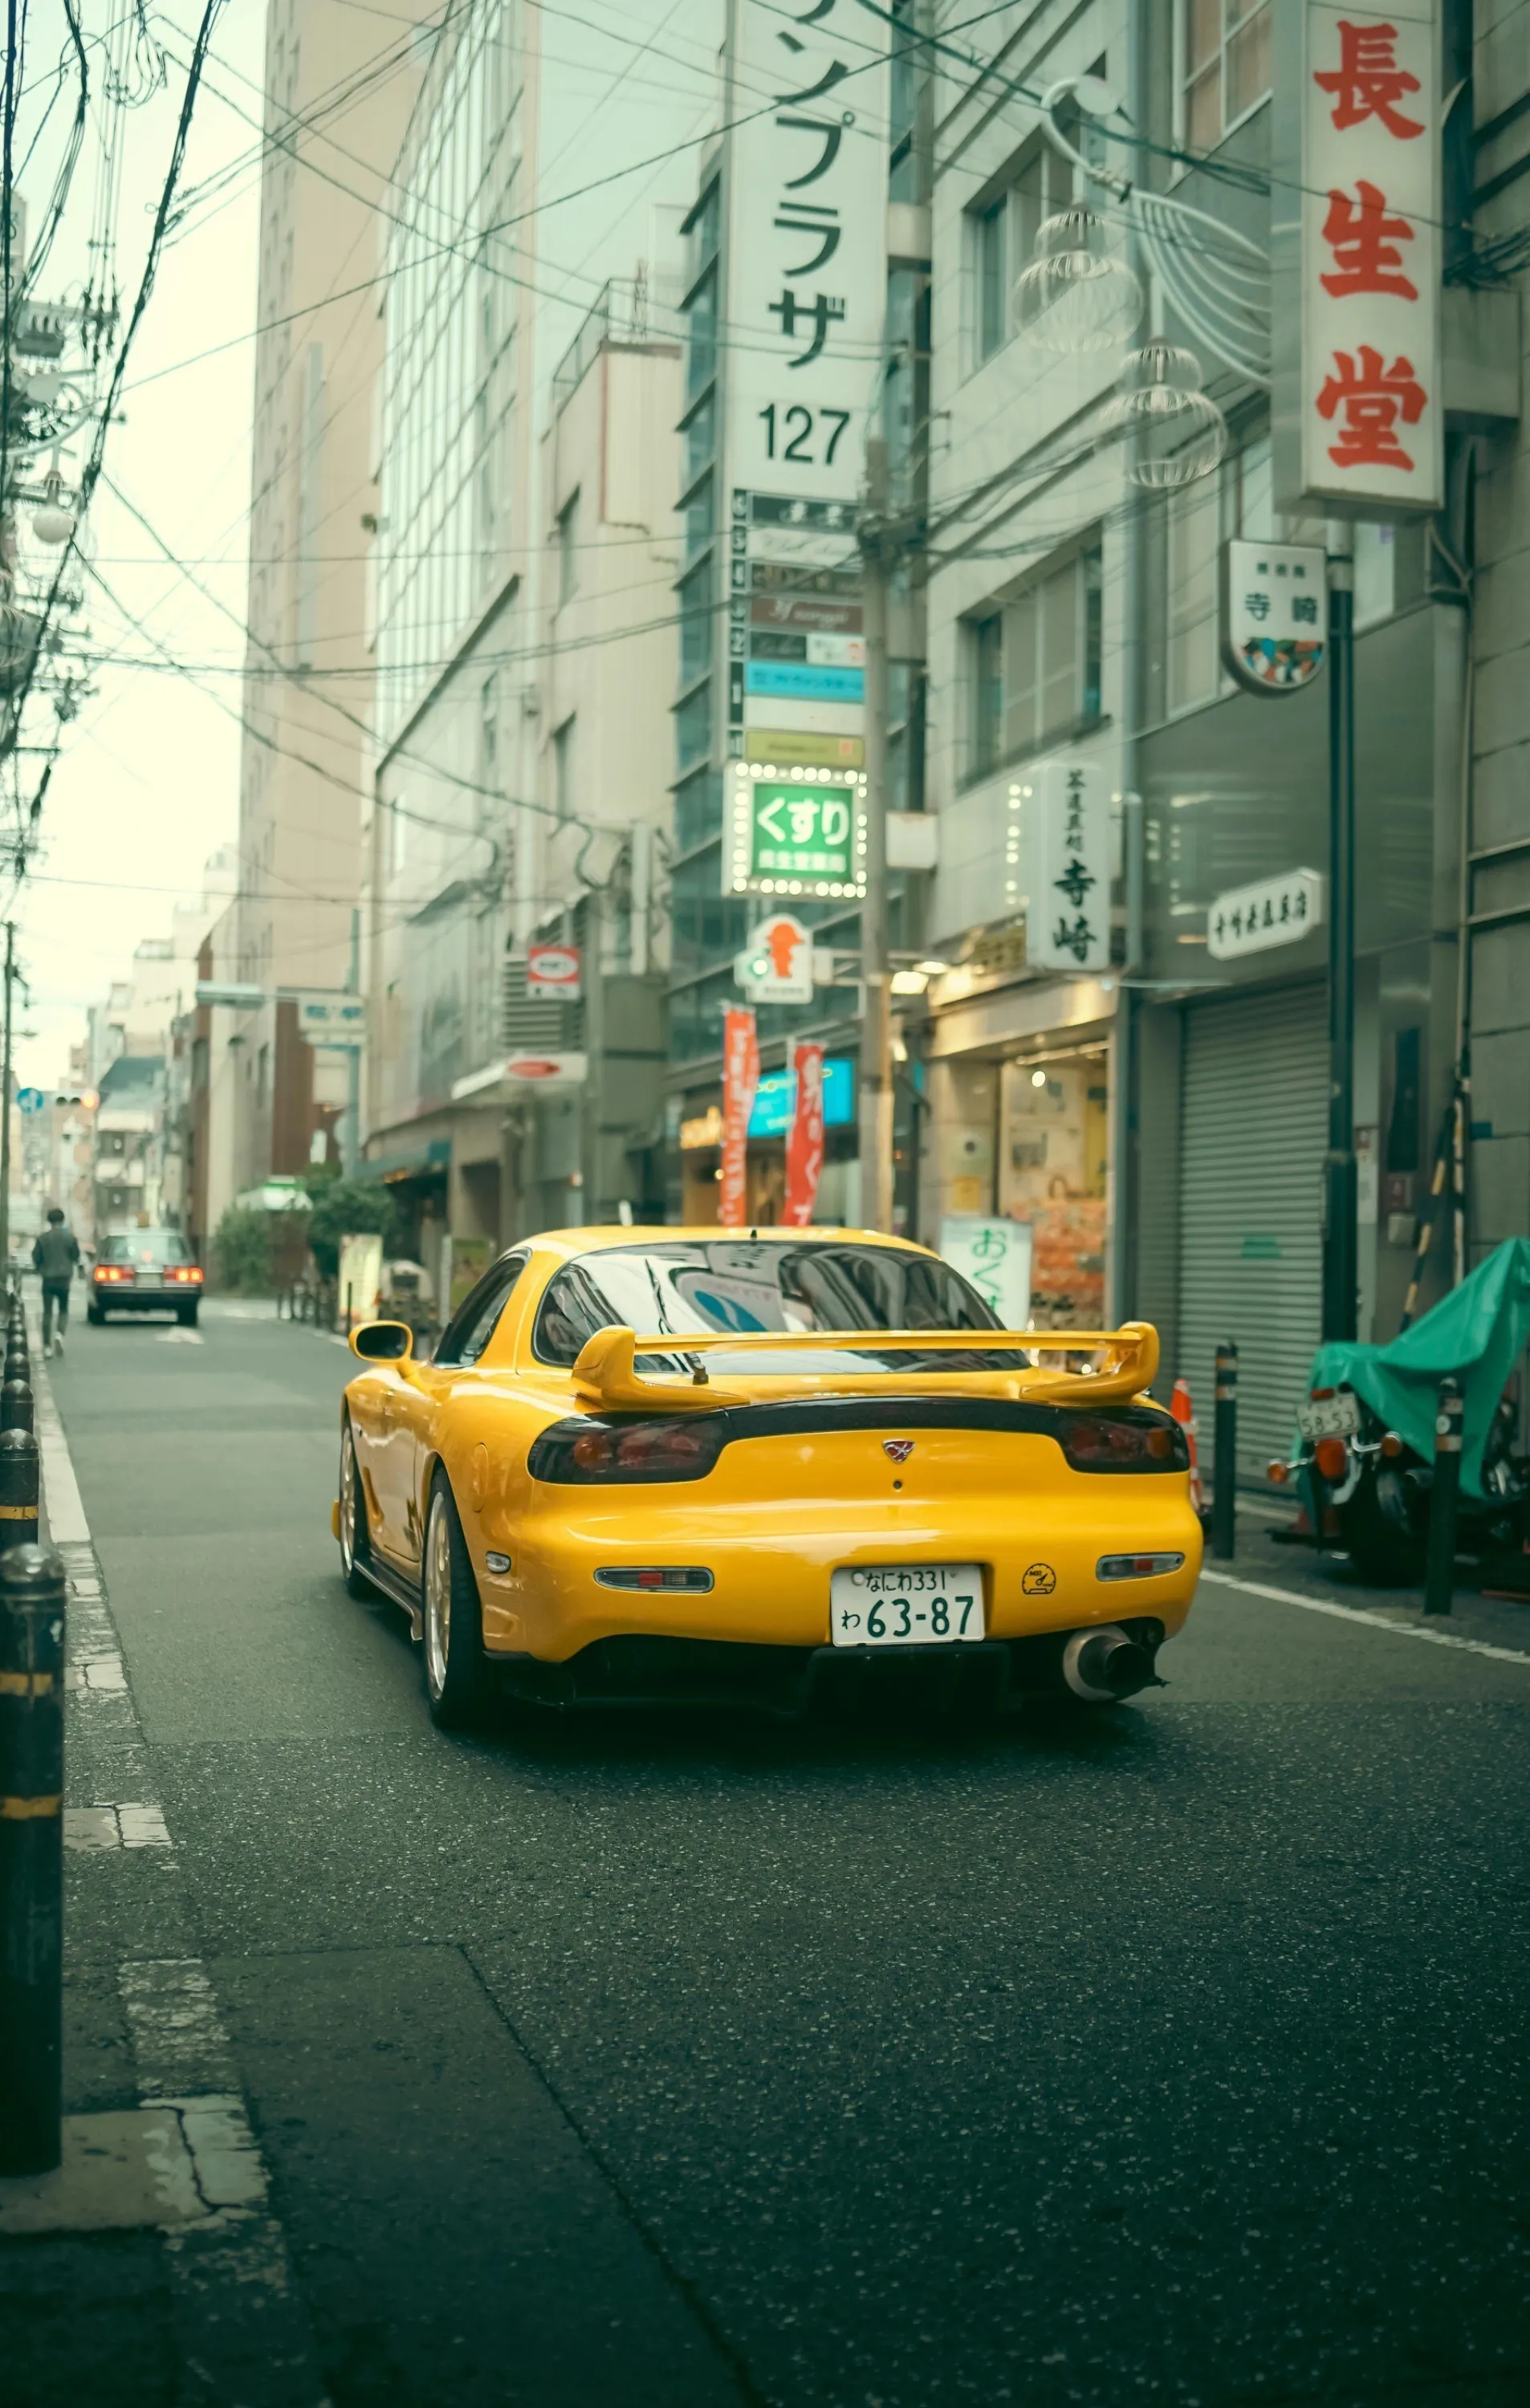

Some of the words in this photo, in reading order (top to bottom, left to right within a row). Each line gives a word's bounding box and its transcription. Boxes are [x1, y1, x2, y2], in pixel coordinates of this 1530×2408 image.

[767, 0, 857, 369] ンプラザ
[1312, 20, 1427, 473] 長生堂
[758, 403, 851, 466] 127
[757, 796, 849, 845] くすり
[841, 1609, 861, 1629] わ
[867, 1596, 974, 1637] 63-87
